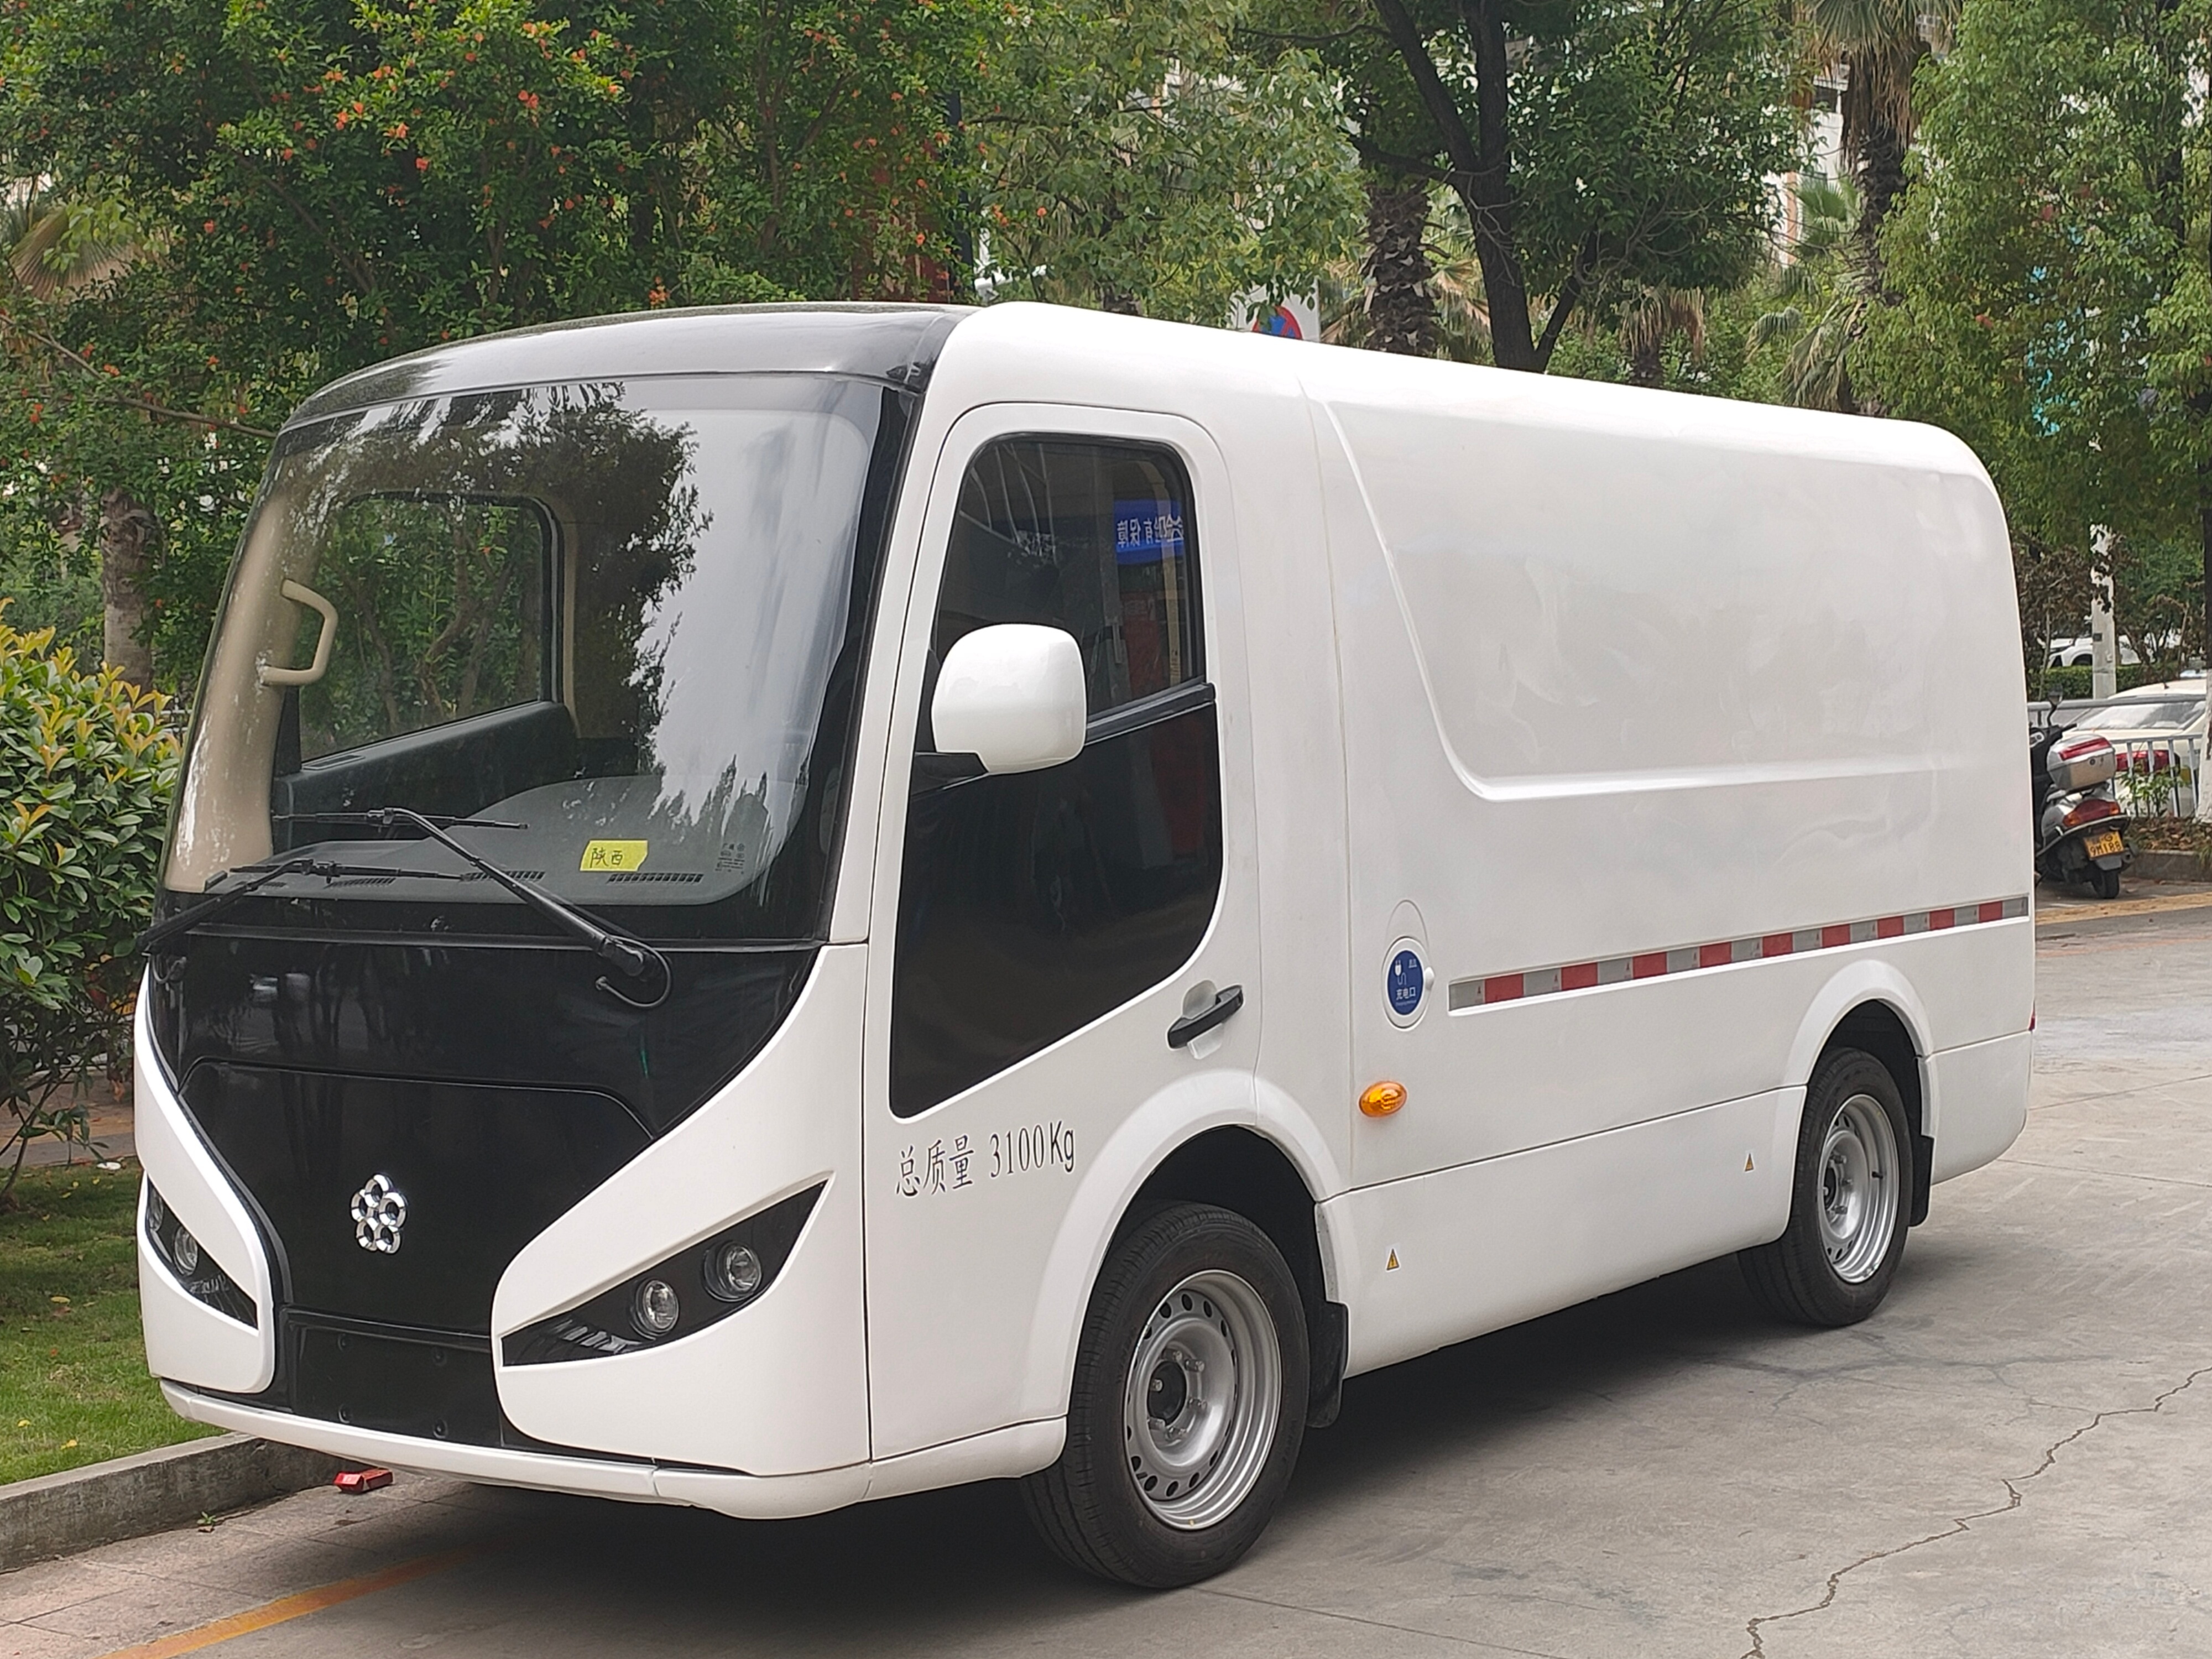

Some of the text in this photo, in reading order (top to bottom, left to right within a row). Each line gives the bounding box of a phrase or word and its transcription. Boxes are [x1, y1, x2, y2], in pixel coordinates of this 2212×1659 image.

[589, 847, 623, 868] 陕西
[896, 1120, 1073, 1197] 总质量 3100Kg
